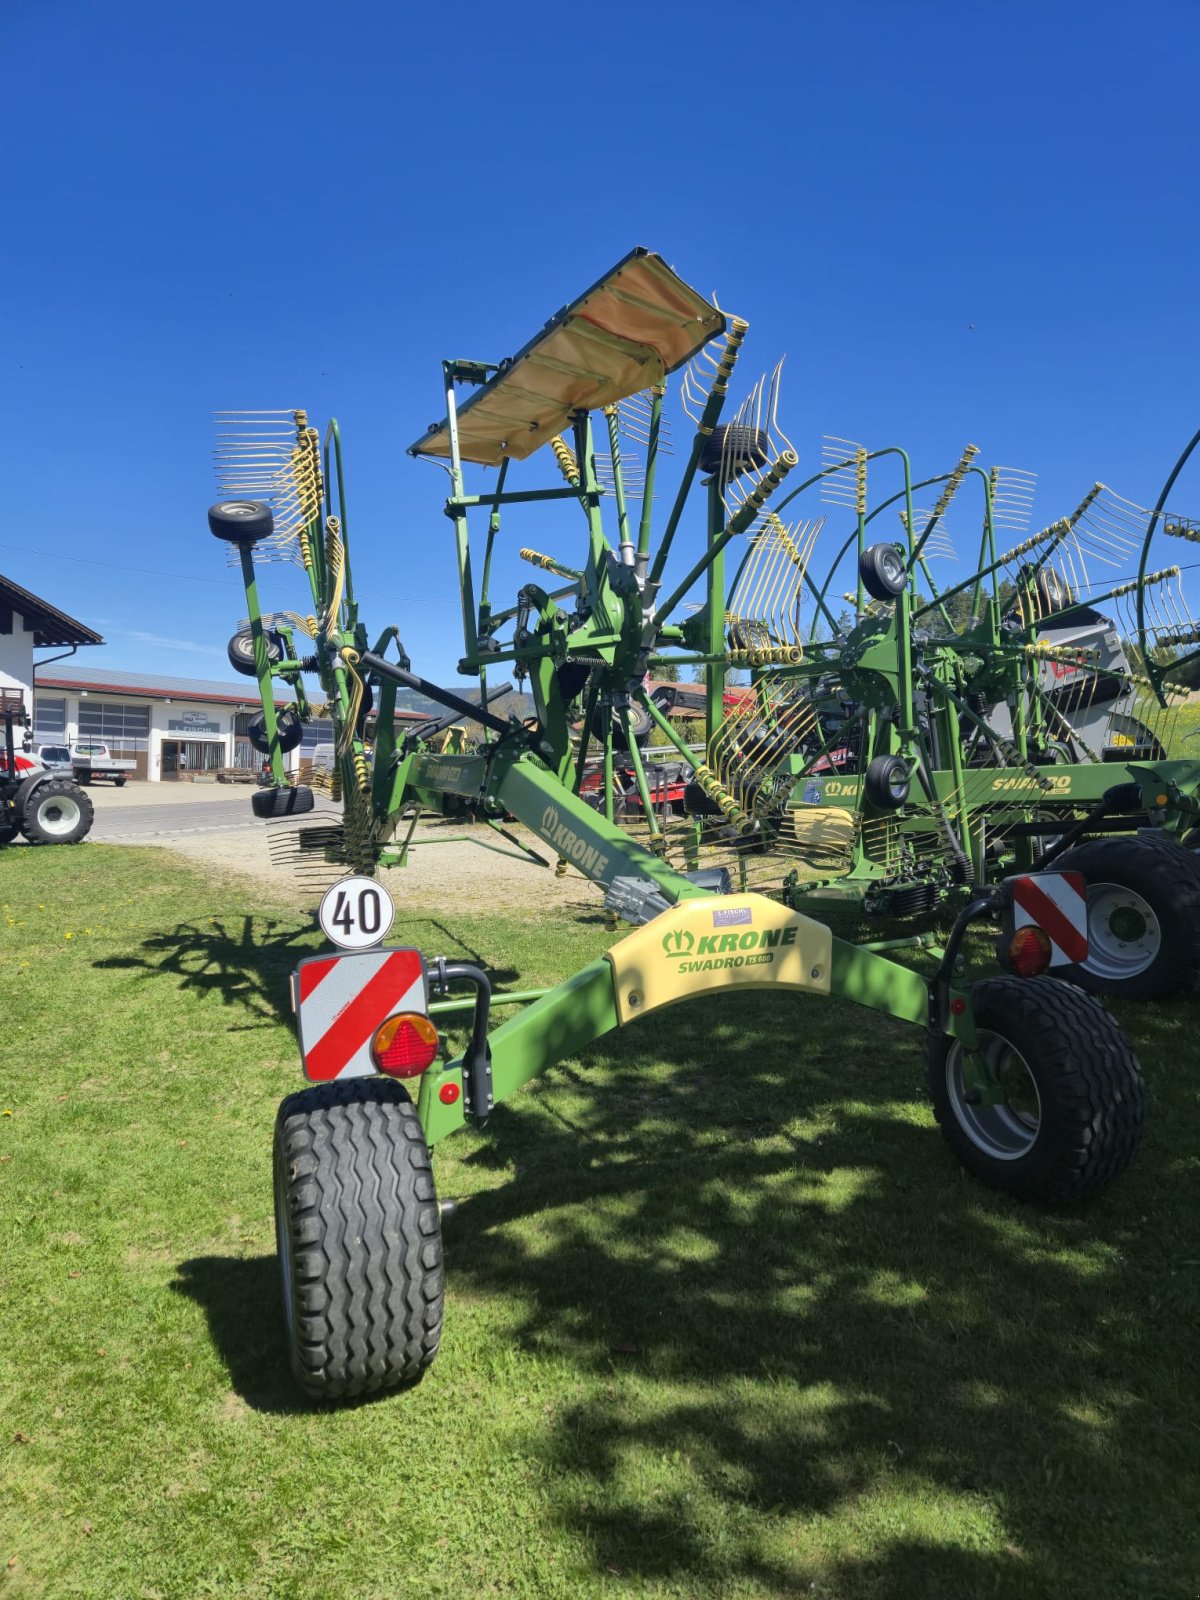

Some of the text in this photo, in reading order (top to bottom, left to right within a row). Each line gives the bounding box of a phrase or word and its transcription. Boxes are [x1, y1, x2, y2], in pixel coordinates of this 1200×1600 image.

[552, 823, 609, 878] KRONE
[331, 888, 382, 936] 40
[696, 926, 799, 955] KRONE
[678, 955, 744, 974] SWADRO
